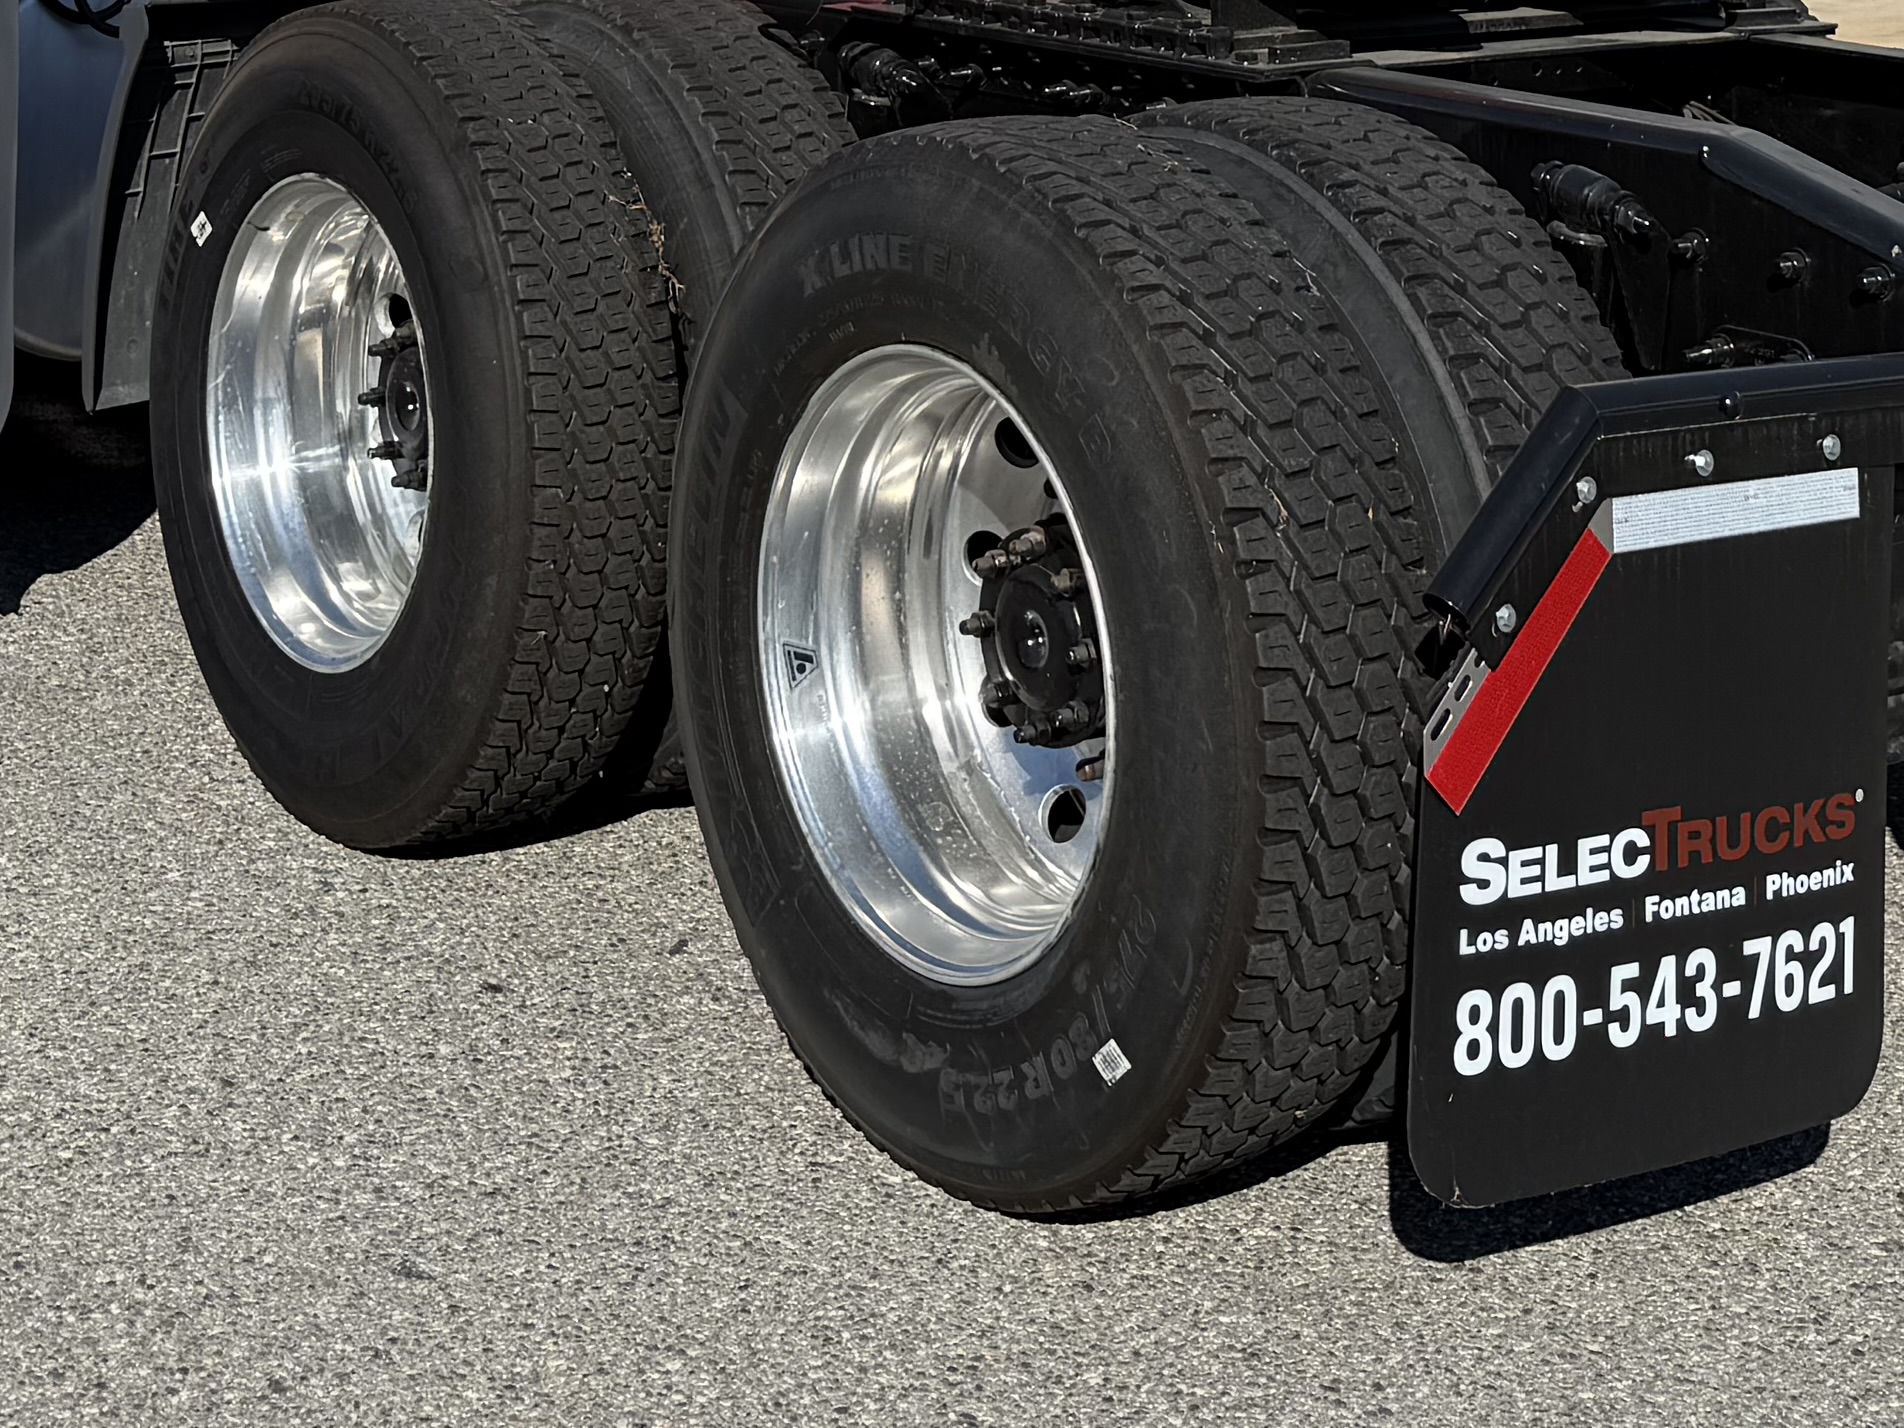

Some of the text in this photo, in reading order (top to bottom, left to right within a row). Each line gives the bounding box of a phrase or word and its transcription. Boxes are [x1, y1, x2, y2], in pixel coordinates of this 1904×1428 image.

[827, 232, 914, 284] LINE
[1459, 793, 1857, 906] SELECTRUCKS
[1459, 859, 1856, 956] Los Angeles Fontana Phoenix
[1453, 915, 1856, 1078] 800-543-7621
